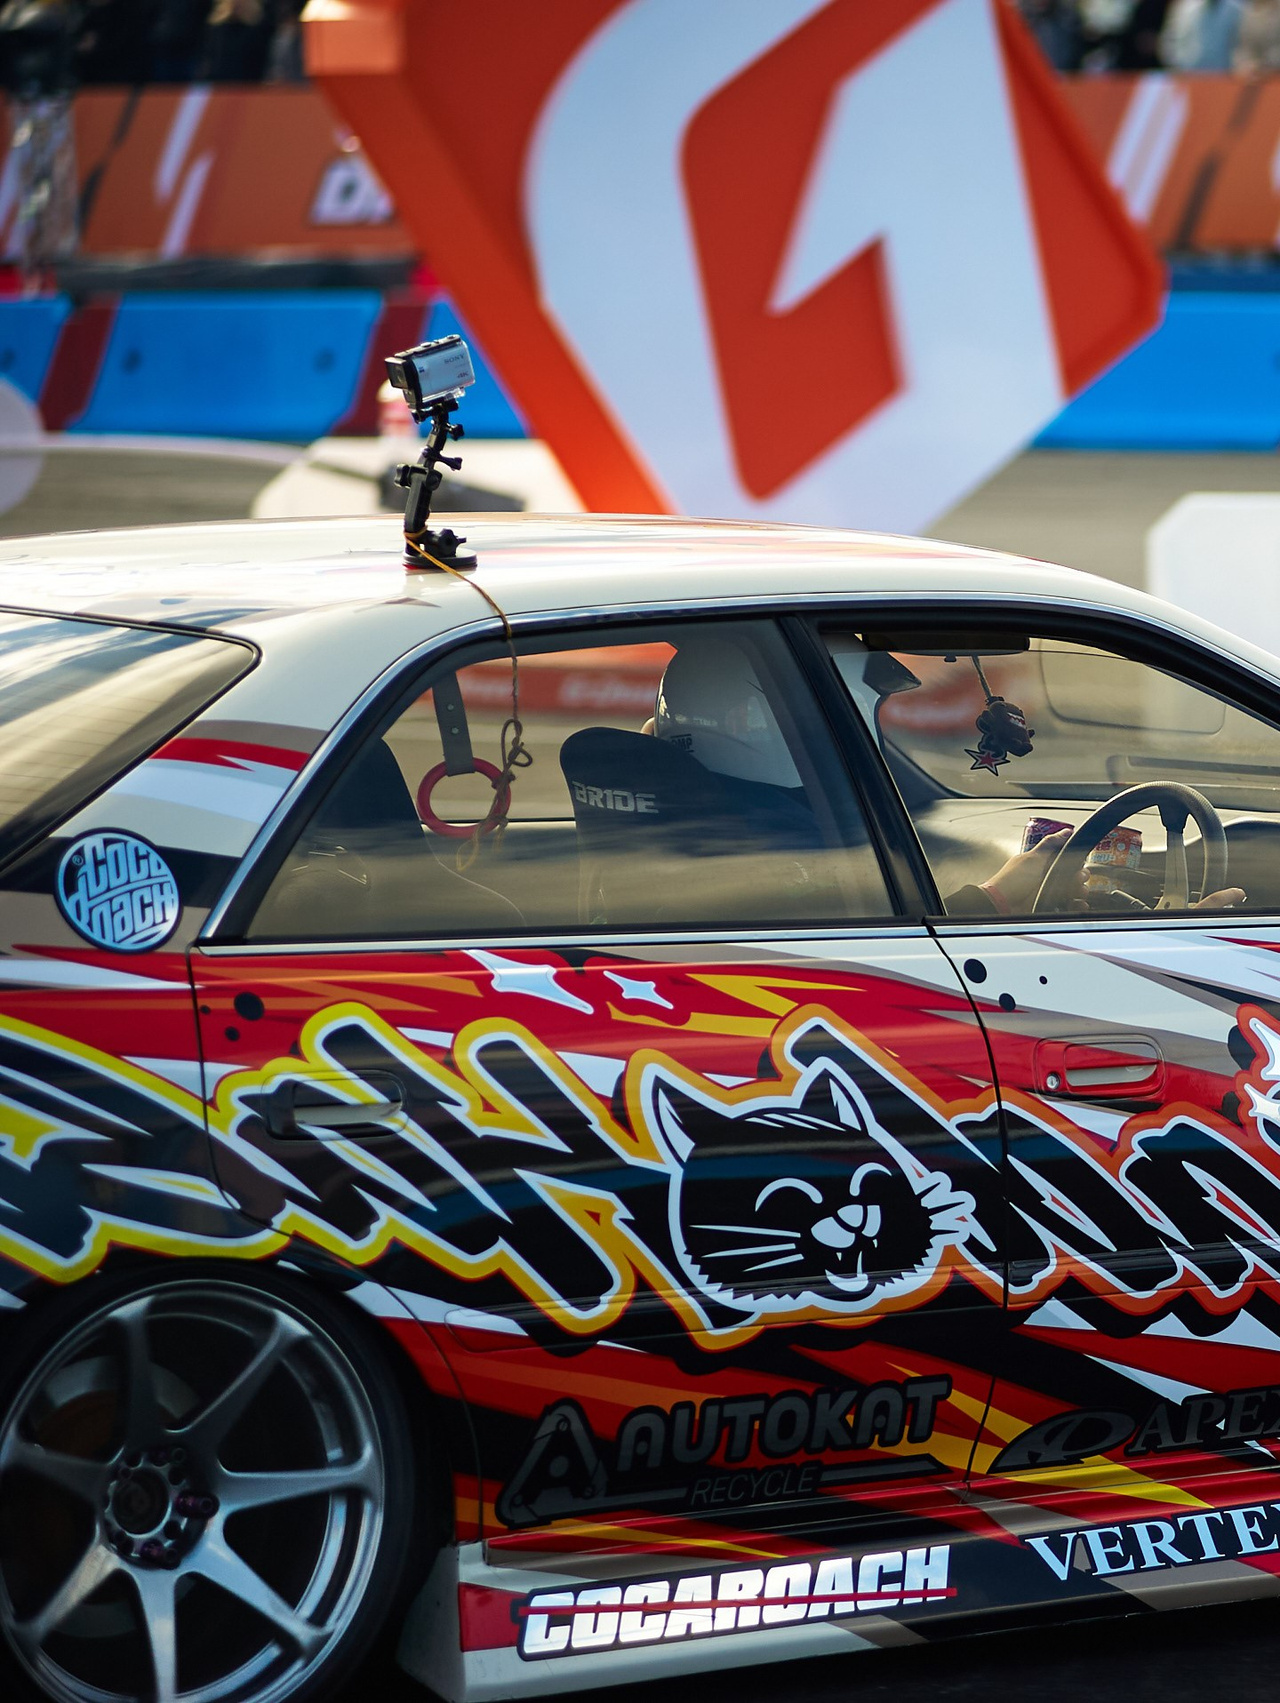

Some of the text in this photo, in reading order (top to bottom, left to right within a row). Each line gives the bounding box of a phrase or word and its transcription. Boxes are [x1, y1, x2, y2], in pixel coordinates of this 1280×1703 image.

[444, 352, 465, 364] SONY
[571, 780, 659, 813] BRIDE
[616, 1380, 948, 1471] AUTOKAT
[692, 1471, 816, 1504] RECYCLE
[522, 1545, 951, 1655] COCAROACH
